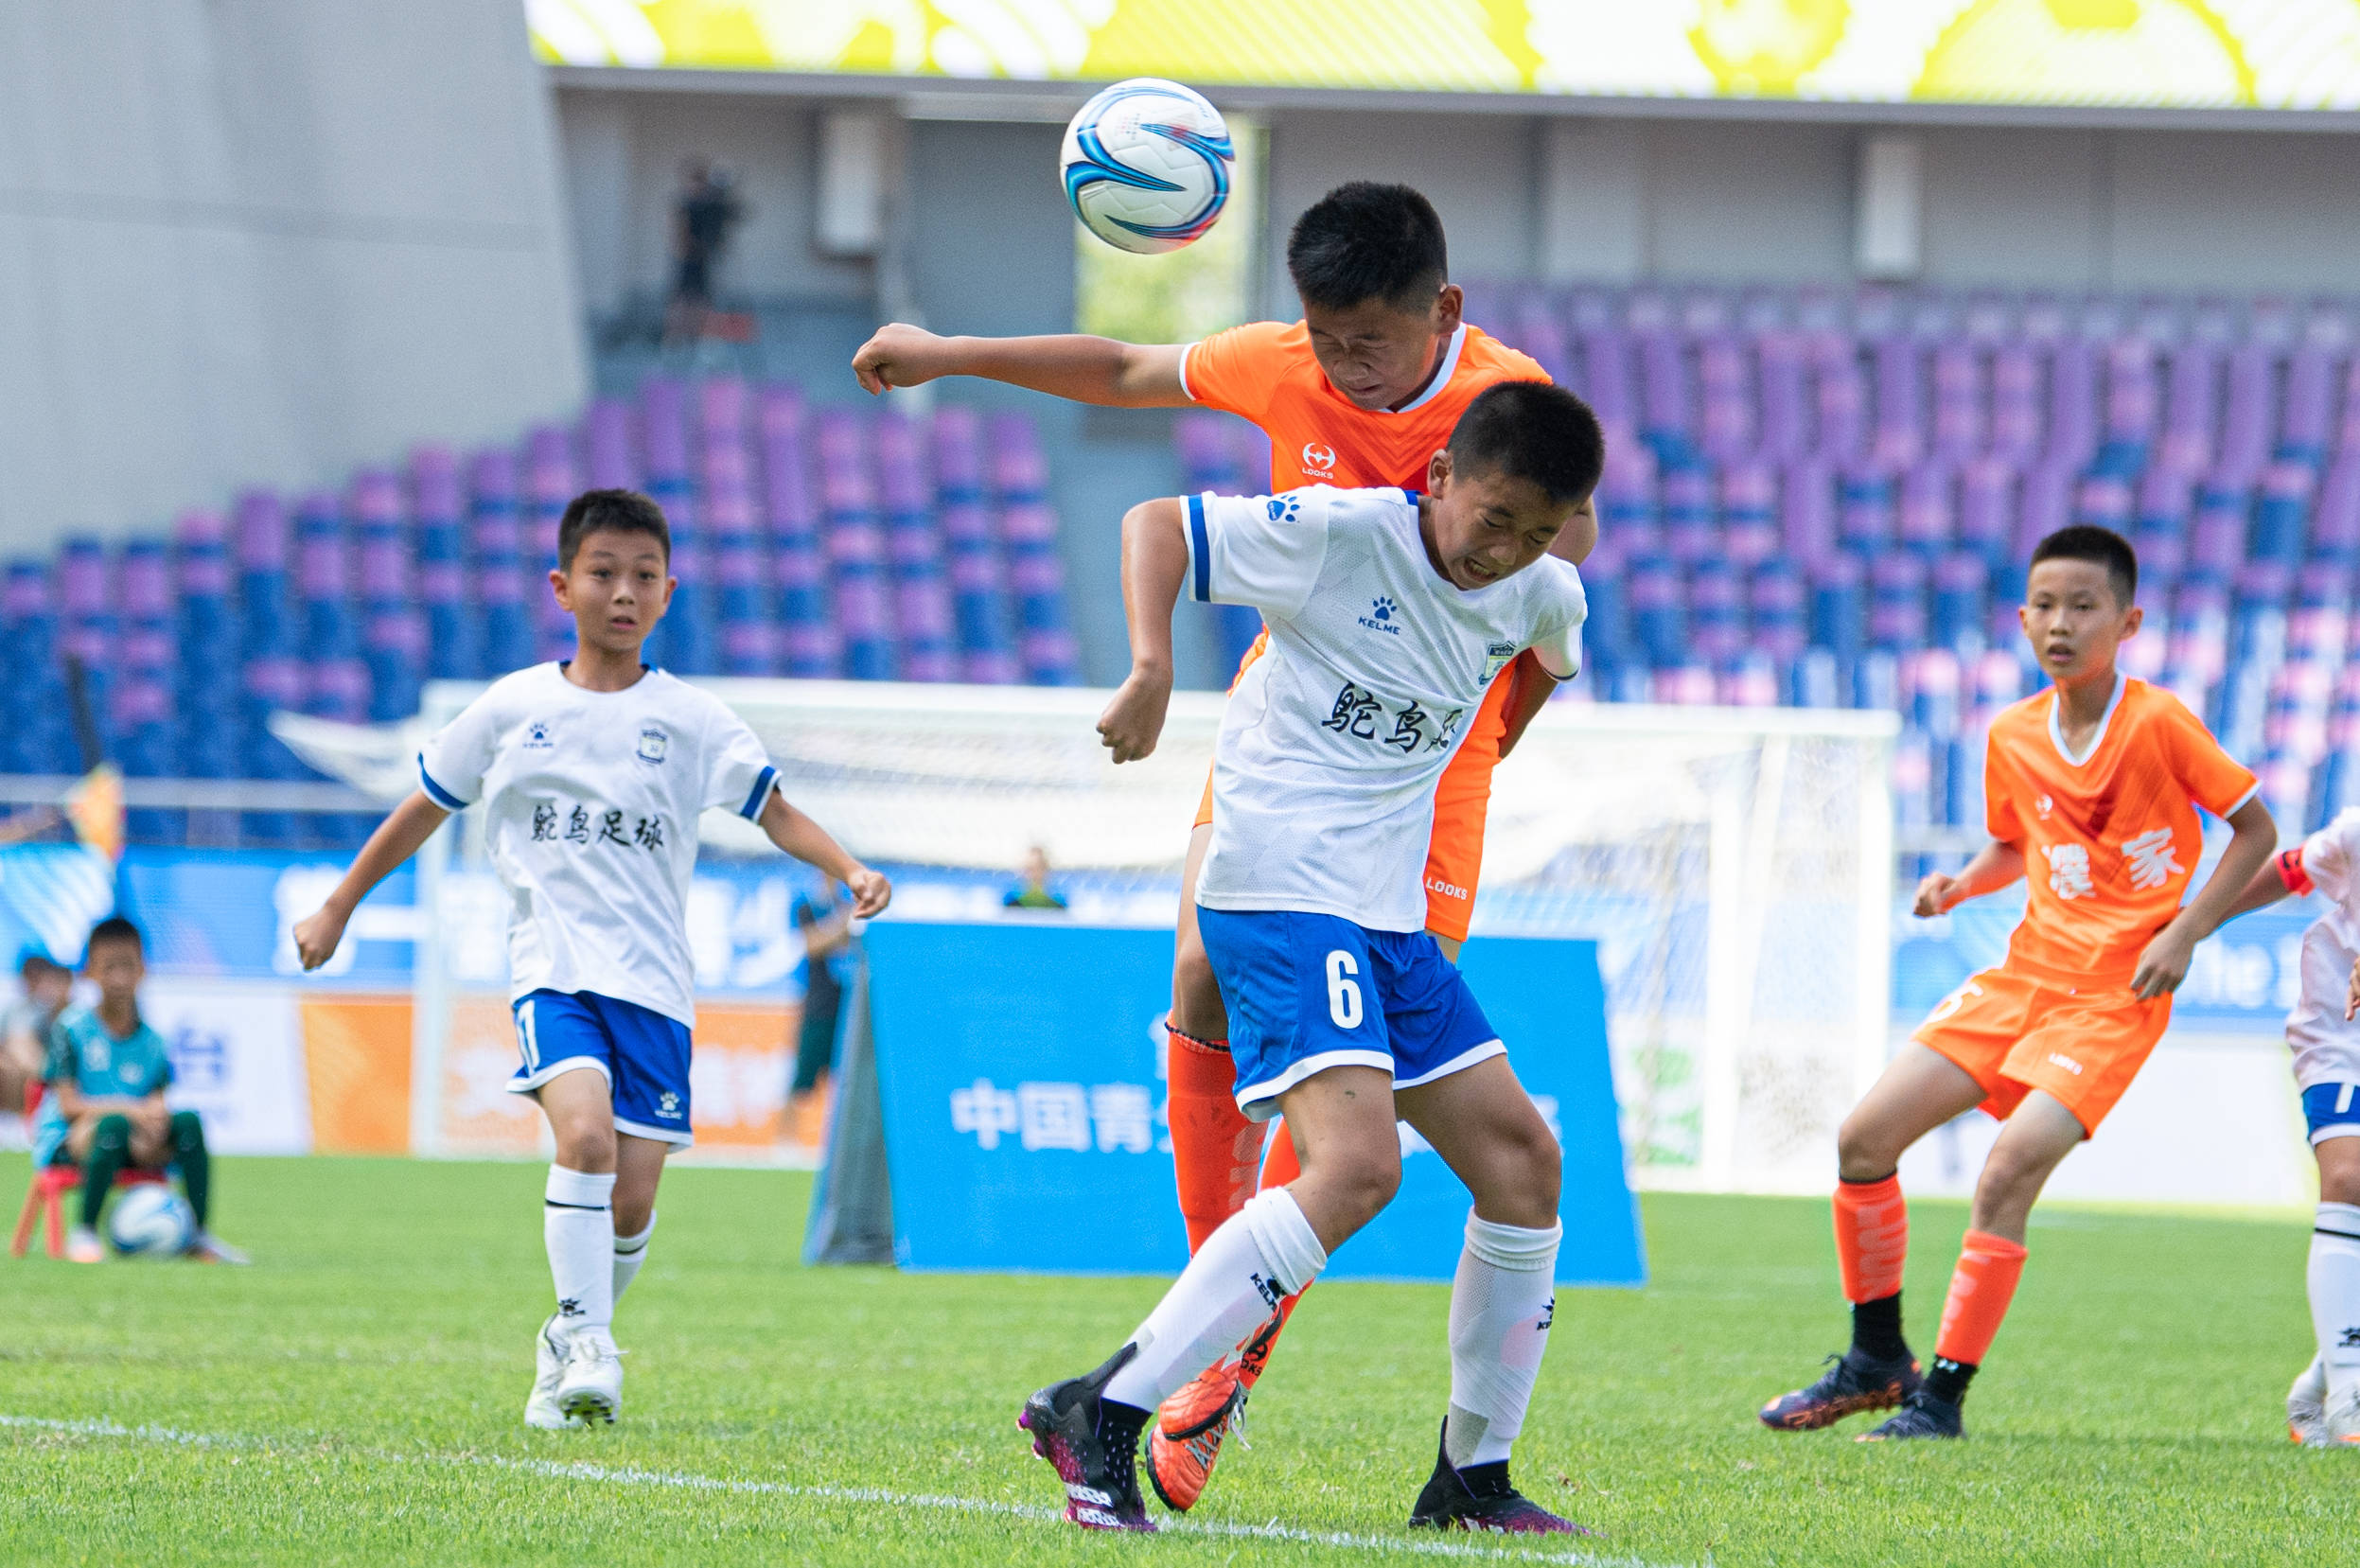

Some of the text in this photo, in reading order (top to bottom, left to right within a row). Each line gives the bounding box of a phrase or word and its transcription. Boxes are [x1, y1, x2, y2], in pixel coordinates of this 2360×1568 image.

[1302, 467, 1334, 480] LOOKS
[1358, 616, 1400, 636] KELME
[531, 804, 664, 853] 鸵鸟足球
[1426, 876, 1468, 901] LOOKS
[1326, 949, 1364, 1030] 6
